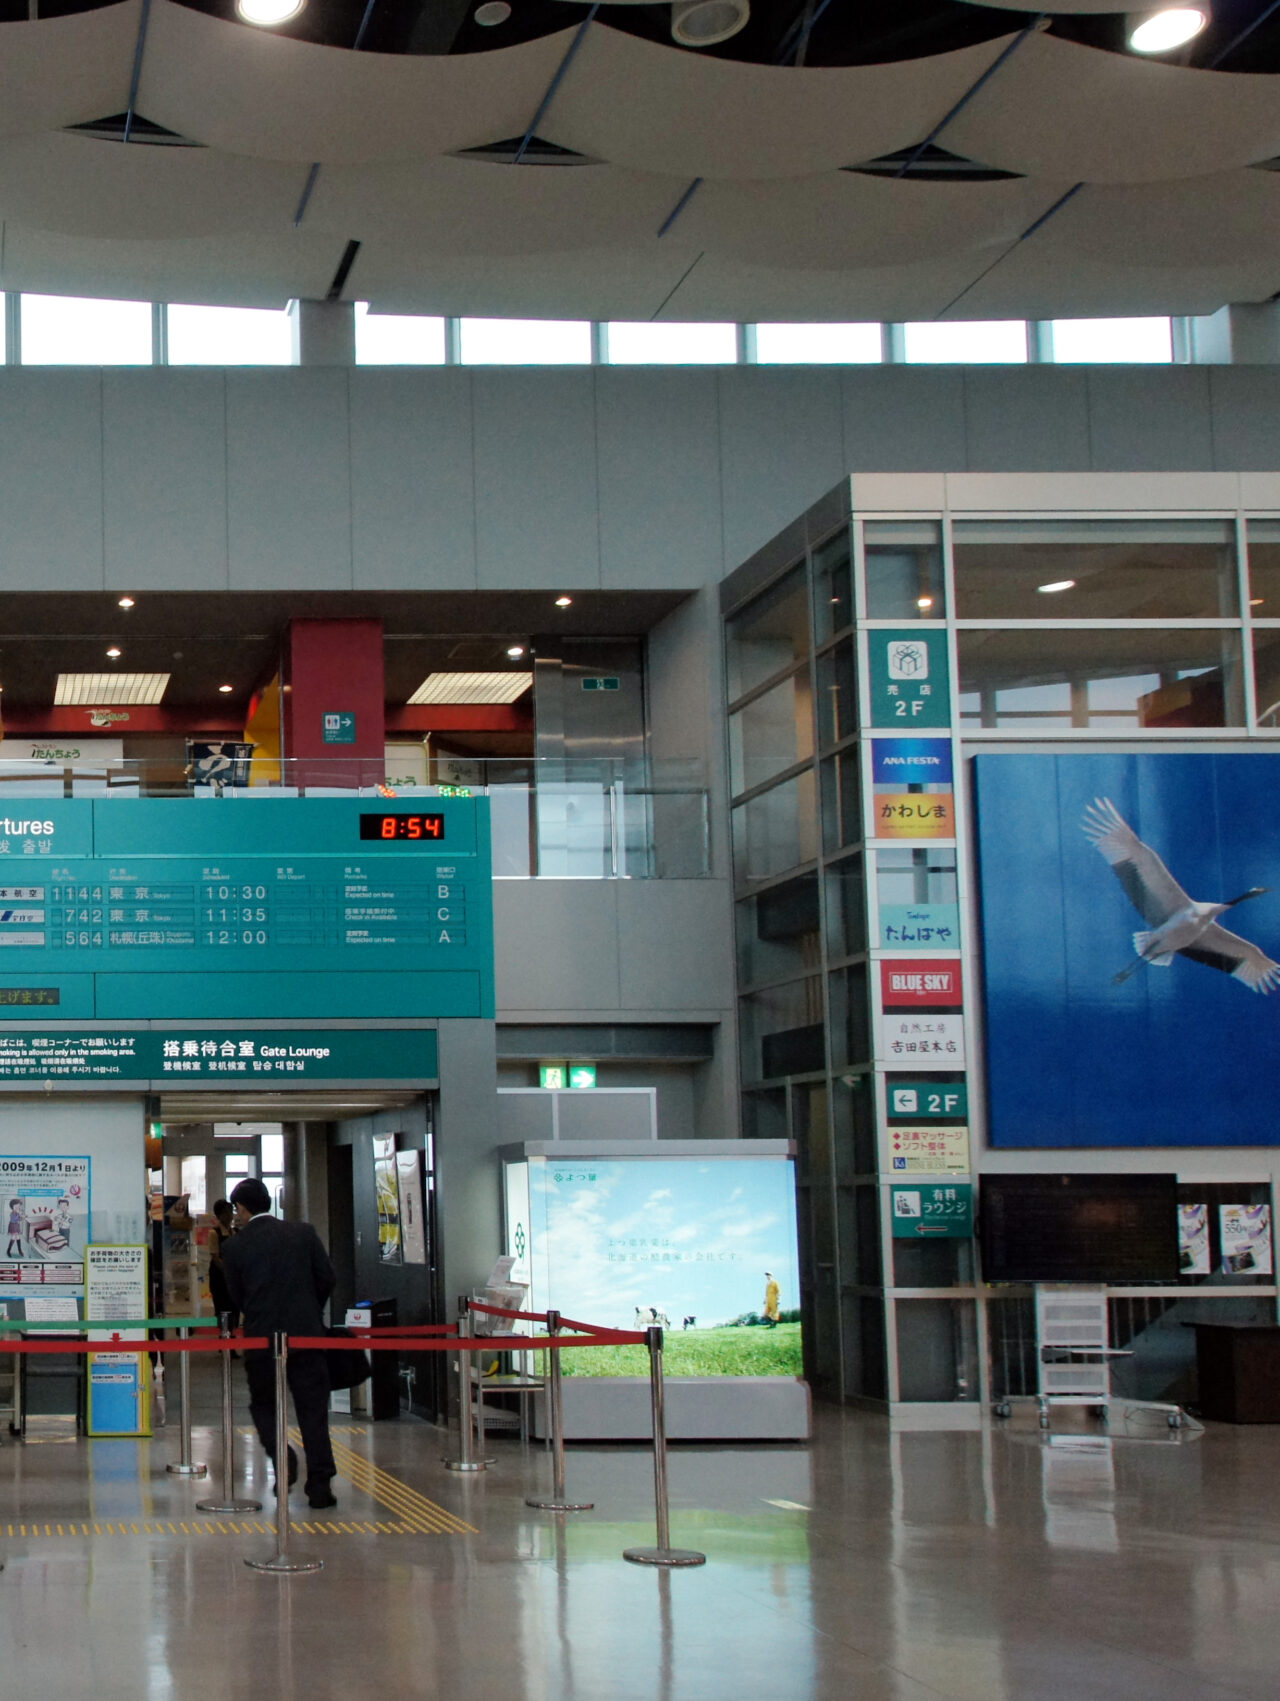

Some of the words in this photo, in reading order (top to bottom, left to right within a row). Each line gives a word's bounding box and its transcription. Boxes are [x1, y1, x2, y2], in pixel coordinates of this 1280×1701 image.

[887, 685, 931, 696] 売店
[895, 700, 924, 716] 2F
[35, 748, 80, 759] たんちょう
[883, 757, 906, 765] ANA
[881, 804, 947, 819] かわしま
[381, 817, 439, 838] 8:54
[22, 839, 52, 854] 출발
[53, 888, 102, 900] 1144
[109, 887, 149, 899] 東京
[206, 886, 266, 899] 10:30
[438, 885, 449, 898] B
[66, 910, 102, 922] 742
[109, 910, 149, 922] 東京
[206, 908, 266, 921] 11:35
[438, 908, 450, 921] C
[66, 932, 102, 945] 564
[206, 931, 266, 944] 12:00
[439, 930, 451, 943] A
[892, 975, 923, 990] BLUE
[924, 975, 949, 990] SKY
[55, 1049, 69, 1057] only
[163, 1040, 255, 1057] 搭乗待合室
[260, 1046, 286, 1056] Gate
[289, 1046, 329, 1058] Lounge
[928, 1095, 958, 1112] 2F
[922, 1202, 967, 1214] ラウンジ
